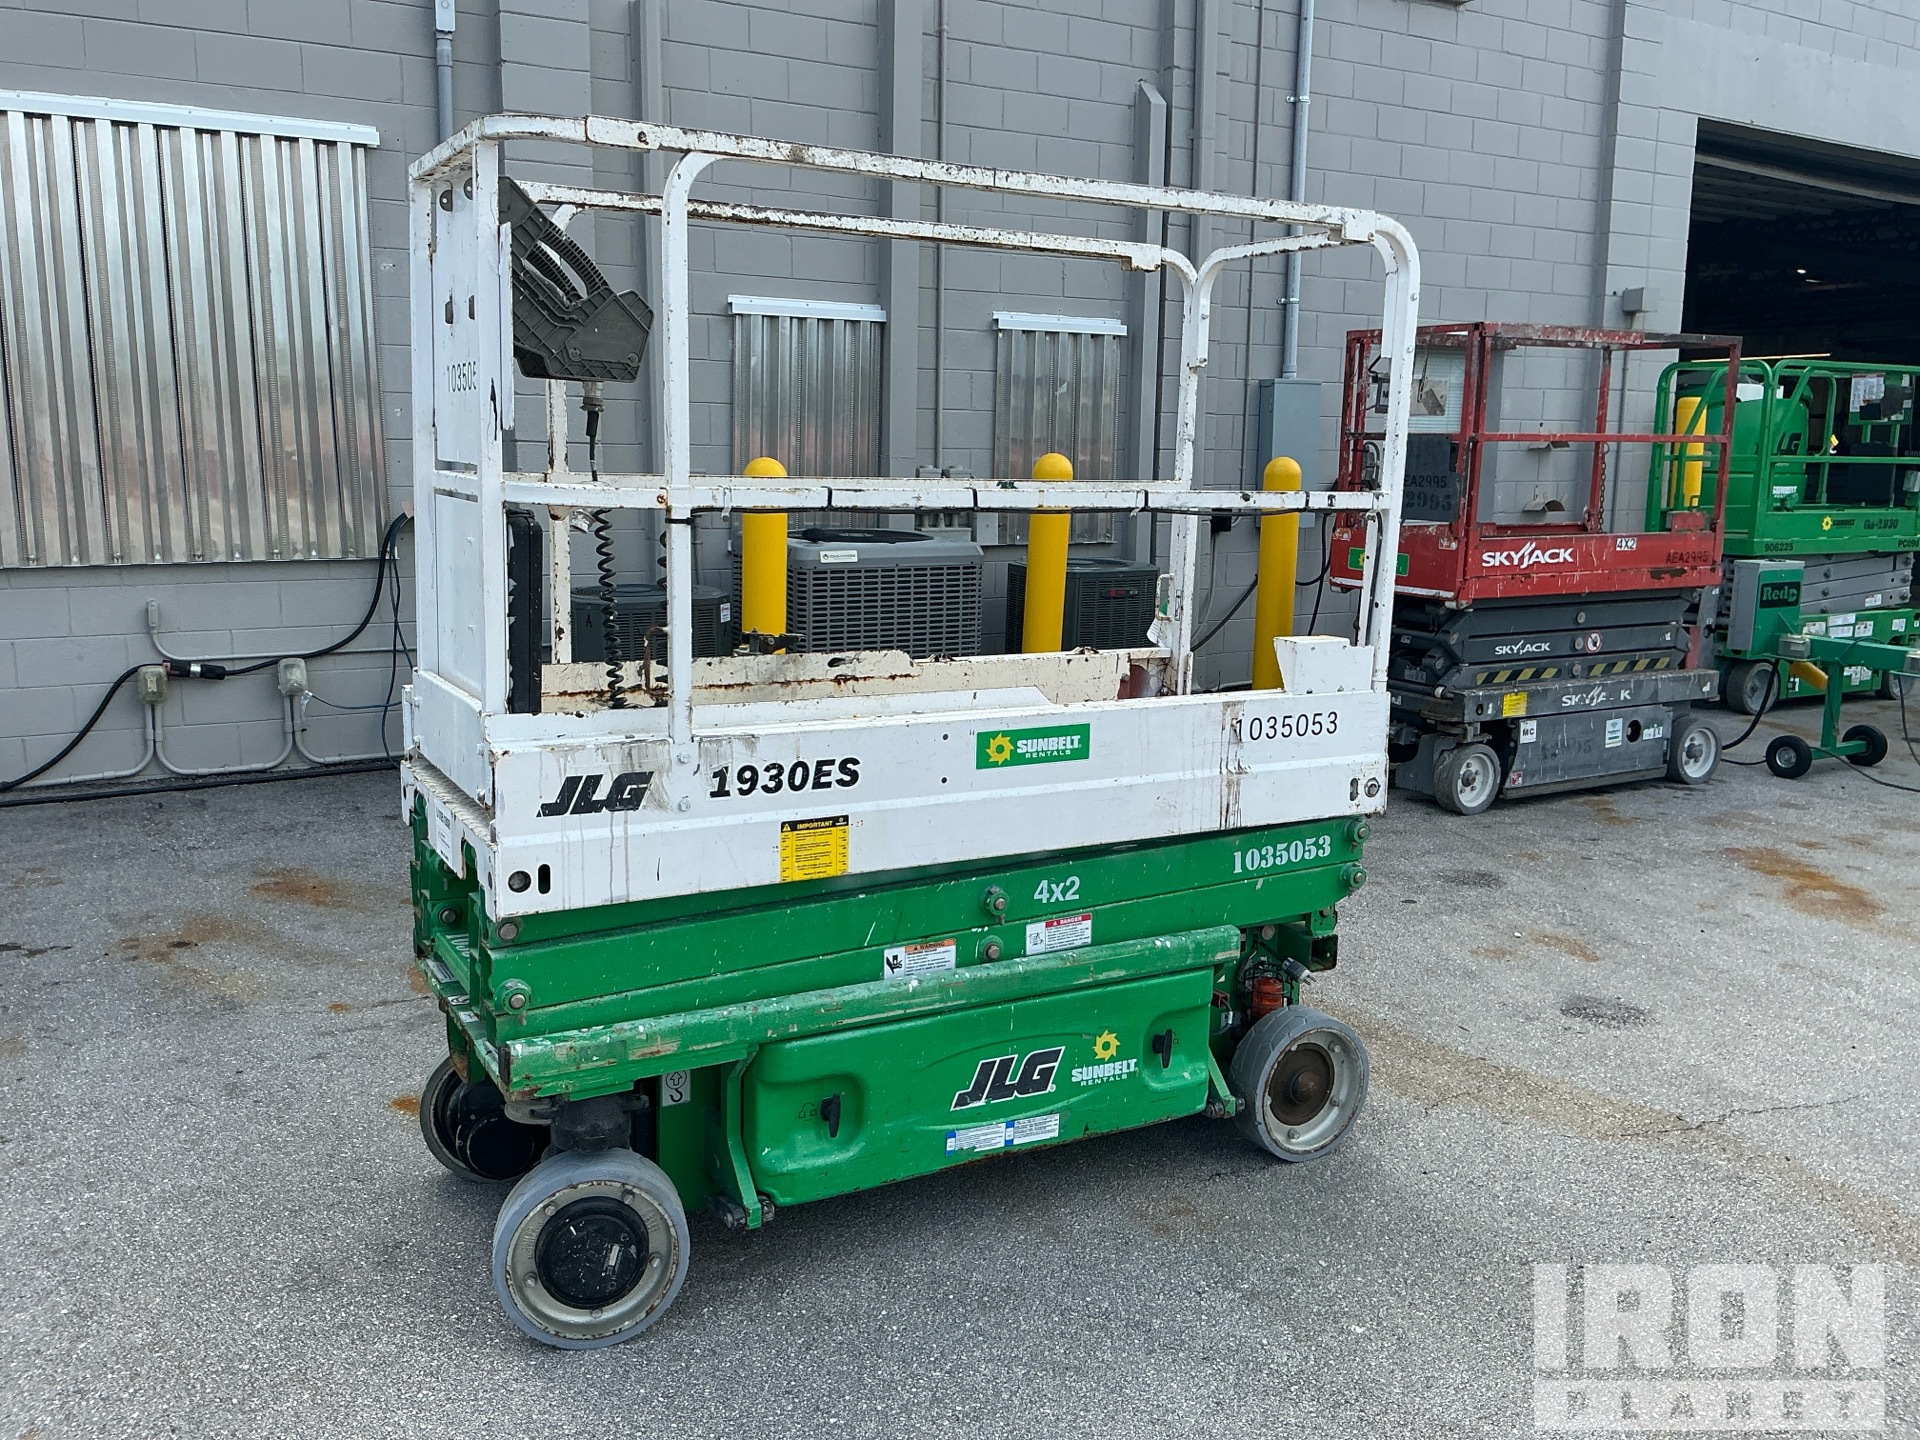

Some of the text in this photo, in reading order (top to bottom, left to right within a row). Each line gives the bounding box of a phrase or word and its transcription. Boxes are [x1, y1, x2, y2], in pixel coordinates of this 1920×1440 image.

[446, 360, 477, 393] 103505
[1403, 474, 1448, 489] EA2995
[1616, 538, 1636, 550] 4X2
[1764, 542, 1794, 552] 906225
[1481, 541, 1574, 569] SKYJACK
[1665, 550, 1709, 565] AEA2995
[1235, 711, 1339, 743] 1035053
[1522, 728, 1535, 737] MC
[1016, 735, 1081, 754] SUNBELT
[1024, 750, 1072, 759] RENTALS
[709, 757, 861, 799] 1930ES
[535, 771, 655, 818] JLG
[796, 820, 834, 830] IMPORTANT
[1232, 835, 1332, 874] 1035053
[1033, 875, 1080, 904] 4x2
[1059, 916, 1083, 925] DANGER
[920, 941, 945, 951] WARNING
[950, 1046, 1066, 1111] JLG
[1071, 1058, 1138, 1082] SUNBELT
[1080, 1074, 1129, 1087] RENTALS
